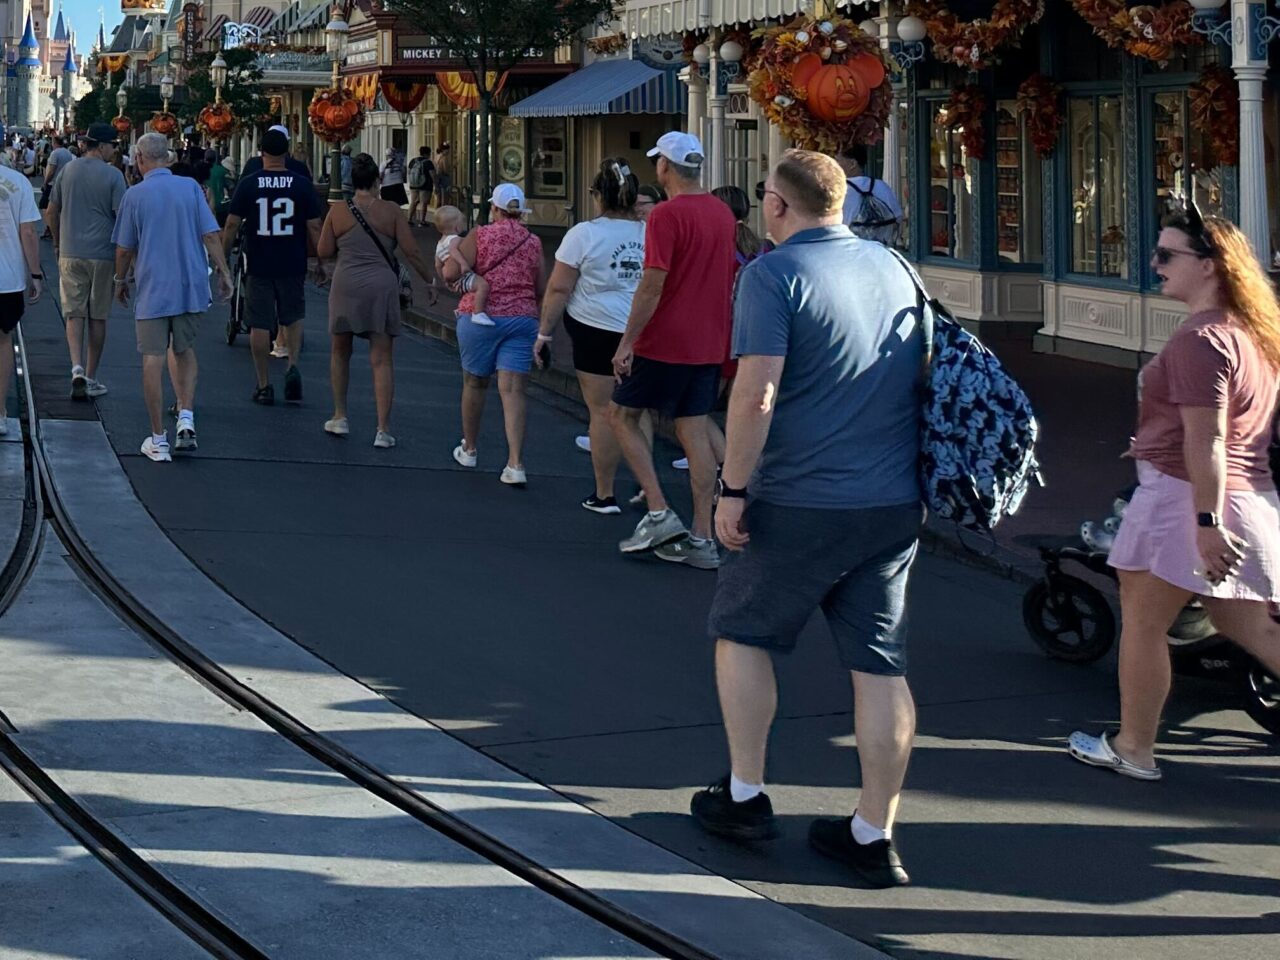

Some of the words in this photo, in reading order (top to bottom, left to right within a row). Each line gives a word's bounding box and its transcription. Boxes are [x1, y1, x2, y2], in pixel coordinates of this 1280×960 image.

[403, 49, 442, 59] MICKEY
[257, 176, 293, 188] BRADY
[255, 197, 294, 236] 12
